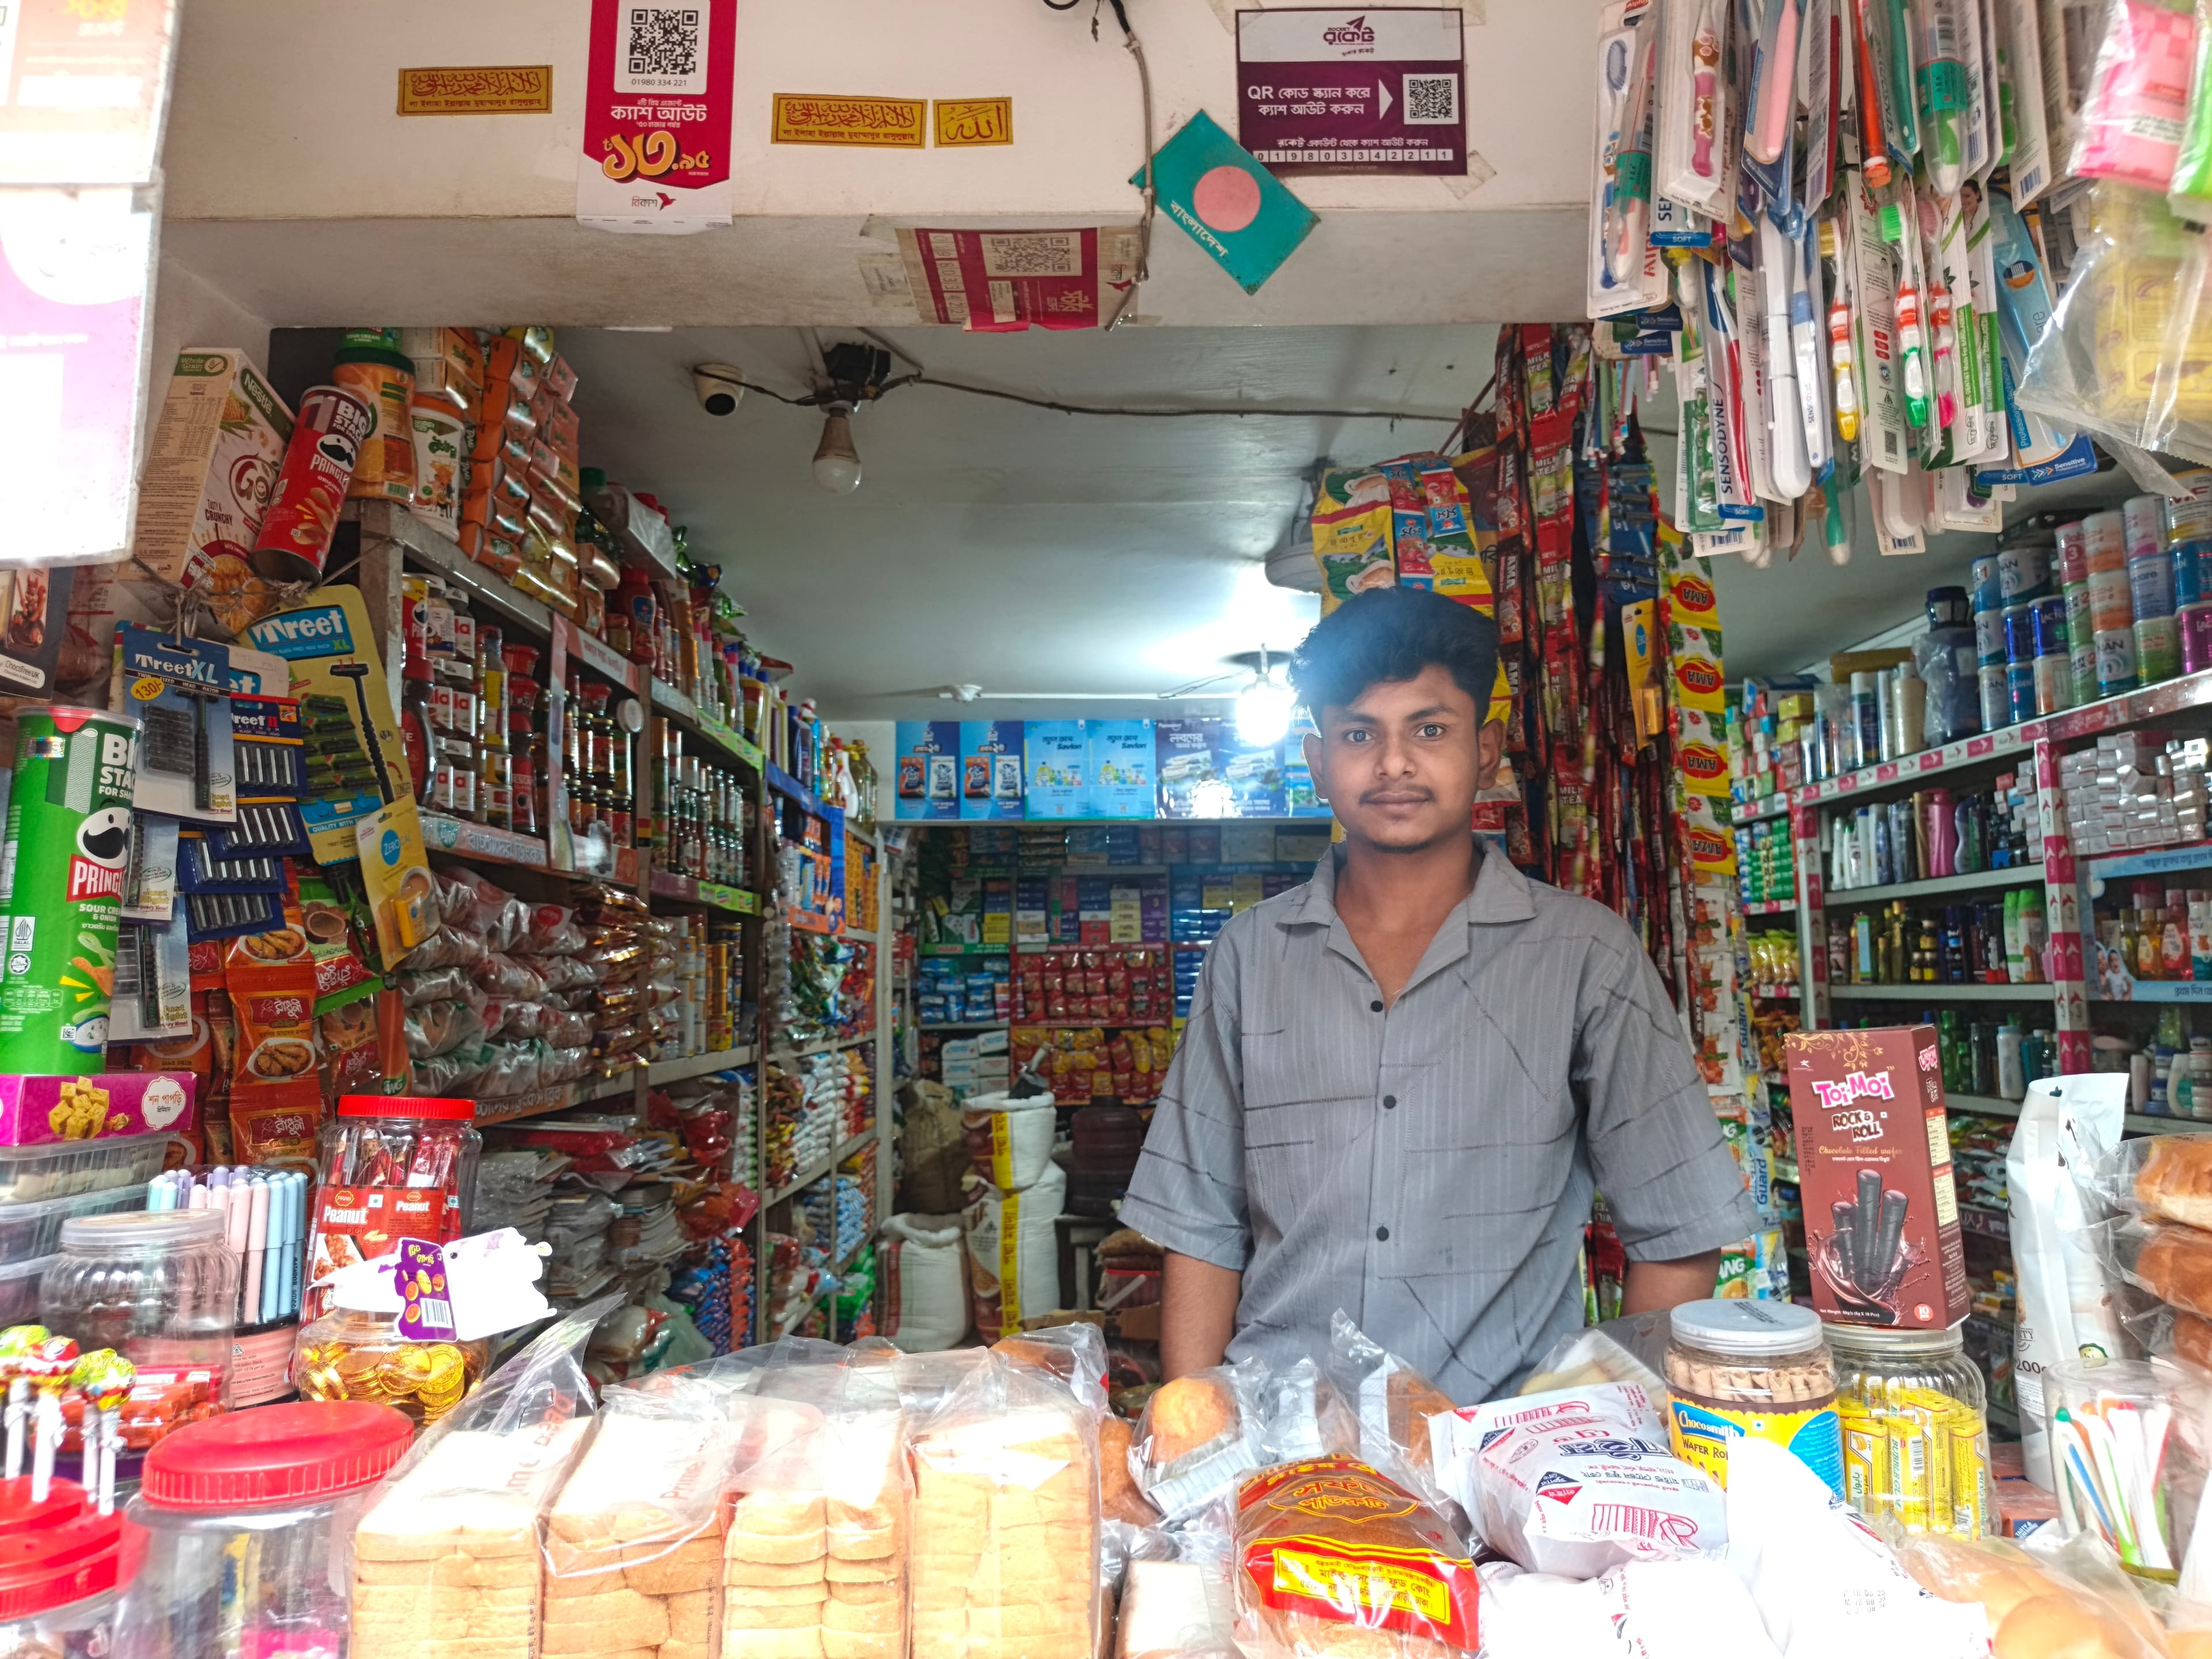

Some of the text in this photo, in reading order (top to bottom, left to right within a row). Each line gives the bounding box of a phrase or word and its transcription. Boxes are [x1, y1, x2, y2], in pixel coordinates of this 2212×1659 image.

[1323, 28, 1375, 45] রকেট
[1248, 86, 1370, 100] QR কোড স্ক্যান করে
[611, 104, 708, 122] ক্যাশ আউট
[1258, 101, 1365, 116] ক্যাশ আউট করুন
[1339, 139, 1358, 147] থেকে
[1381, 138, 1404, 147] আউট
[631, 196, 658, 207] বিকাশ
[1171, 200, 1229, 257] বাংলাদেশ
[1958, 309, 1967, 347] BANGLADESH
[1981, 316, 1990, 353] BANGLADESH
[1643, 337, 1669, 345] Sensitive
[1527, 350, 1551, 367] MILK
[1528, 362, 1549, 374] TEA
[2001, 360, 2014, 400] Technology
[337, 400, 368, 433] BIG
[1713, 398, 1733, 494] SENSODYNE
[2054, 457, 2086, 469] Sensitive
[205, 509, 233, 525] CRUNCHY
[2069, 547, 2080, 558] 3
[1683, 588, 1709, 604] AMA
[332, 639, 350, 650] XL
[2097, 639, 2124, 654] NAN
[1687, 669, 1715, 687] AMA
[135, 679, 163, 699] 130/-
[202, 686, 219, 694] RAZOR
[103, 733, 136, 772] BI
[1122, 741, 1146, 749] Savlon
[1687, 755, 1717, 771] AMA
[99, 785, 118, 796] FOR
[1560, 794, 1583, 805] TEA
[312, 819, 354, 833] QUALITY WITH
[1691, 839, 1722, 857] AMA
[79, 904, 106, 912] SOUR
[275, 998, 303, 1018] রাঁধুনী
[1737, 1002, 1749, 1048] Guard
[147, 1091, 182, 1107] শন পাপড়ি
[275, 1116, 305, 1138] রাঁধুনী
[1832, 1112, 1871, 1128] ROCK &
[1852, 1122, 1881, 1140] ROLL
[1819, 1146, 1853, 1156] Chocolate
[1856, 1146, 1878, 1155] Filled
[1756, 1157, 1768, 1205] Guard
[396, 1201, 430, 1211] Peanut
[324, 1206, 369, 1224] Peanut
[1918, 1305, 1929, 1314] 10
[2017, 1360, 2047, 1374] 200
[1683, 1440, 1708, 1456] WAFER
[1581, 1471, 1602, 1479] কোং
[1604, 1471, 1622, 1479] ফুড
[1298, 1494, 1390, 1509] পাউরুটি
[1389, 1577, 1407, 1589] ফুড
[1411, 1583, 1431, 1599] কোং
[1415, 1596, 1433, 1610] ঢাকা।
